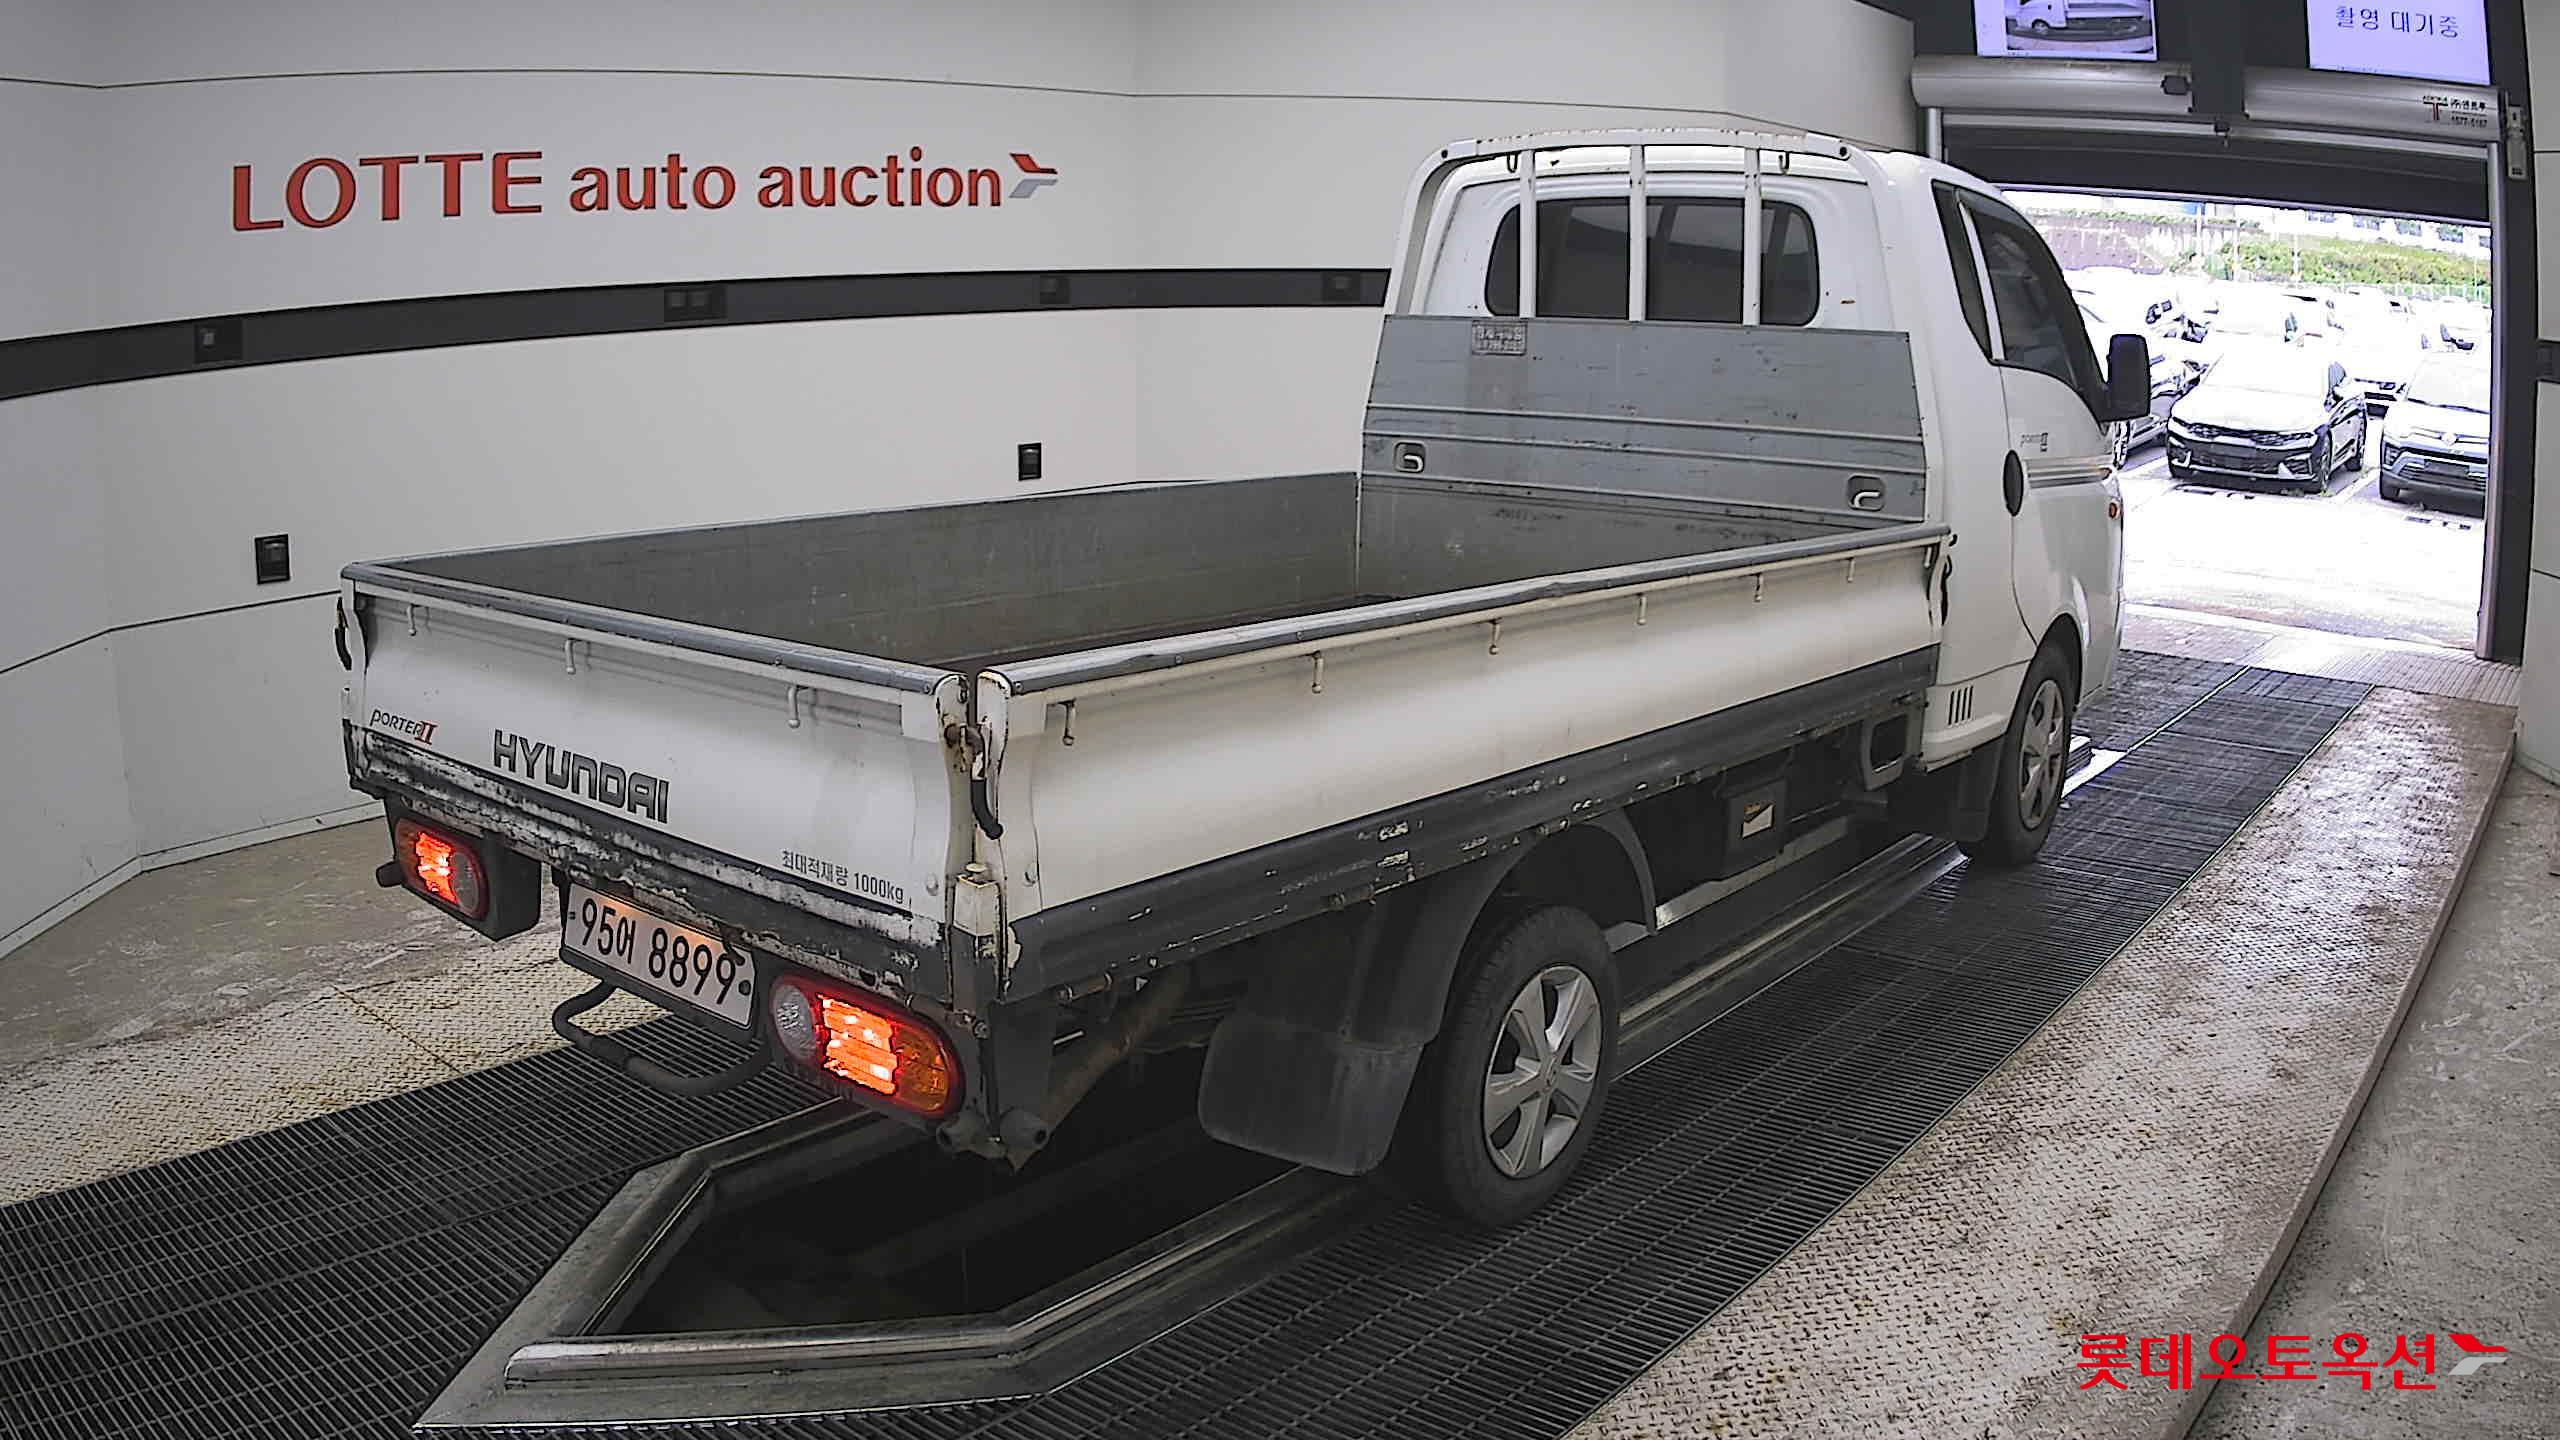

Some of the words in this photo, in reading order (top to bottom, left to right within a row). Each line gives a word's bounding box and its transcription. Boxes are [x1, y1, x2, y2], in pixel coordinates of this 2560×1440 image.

[2391, 11, 2458, 39] 대기중
[233, 151, 543, 232] LOTTE
[569, 152, 736, 212] auto
[757, 146, 1002, 208] auction
[494, 729, 670, 824] HYUNDAI
[782, 849, 849, 887] 최대적재량
[854, 871, 904, 904] 1000kg
[581, 897, 636, 965] 95어
[648, 927, 736, 1005] 8899
